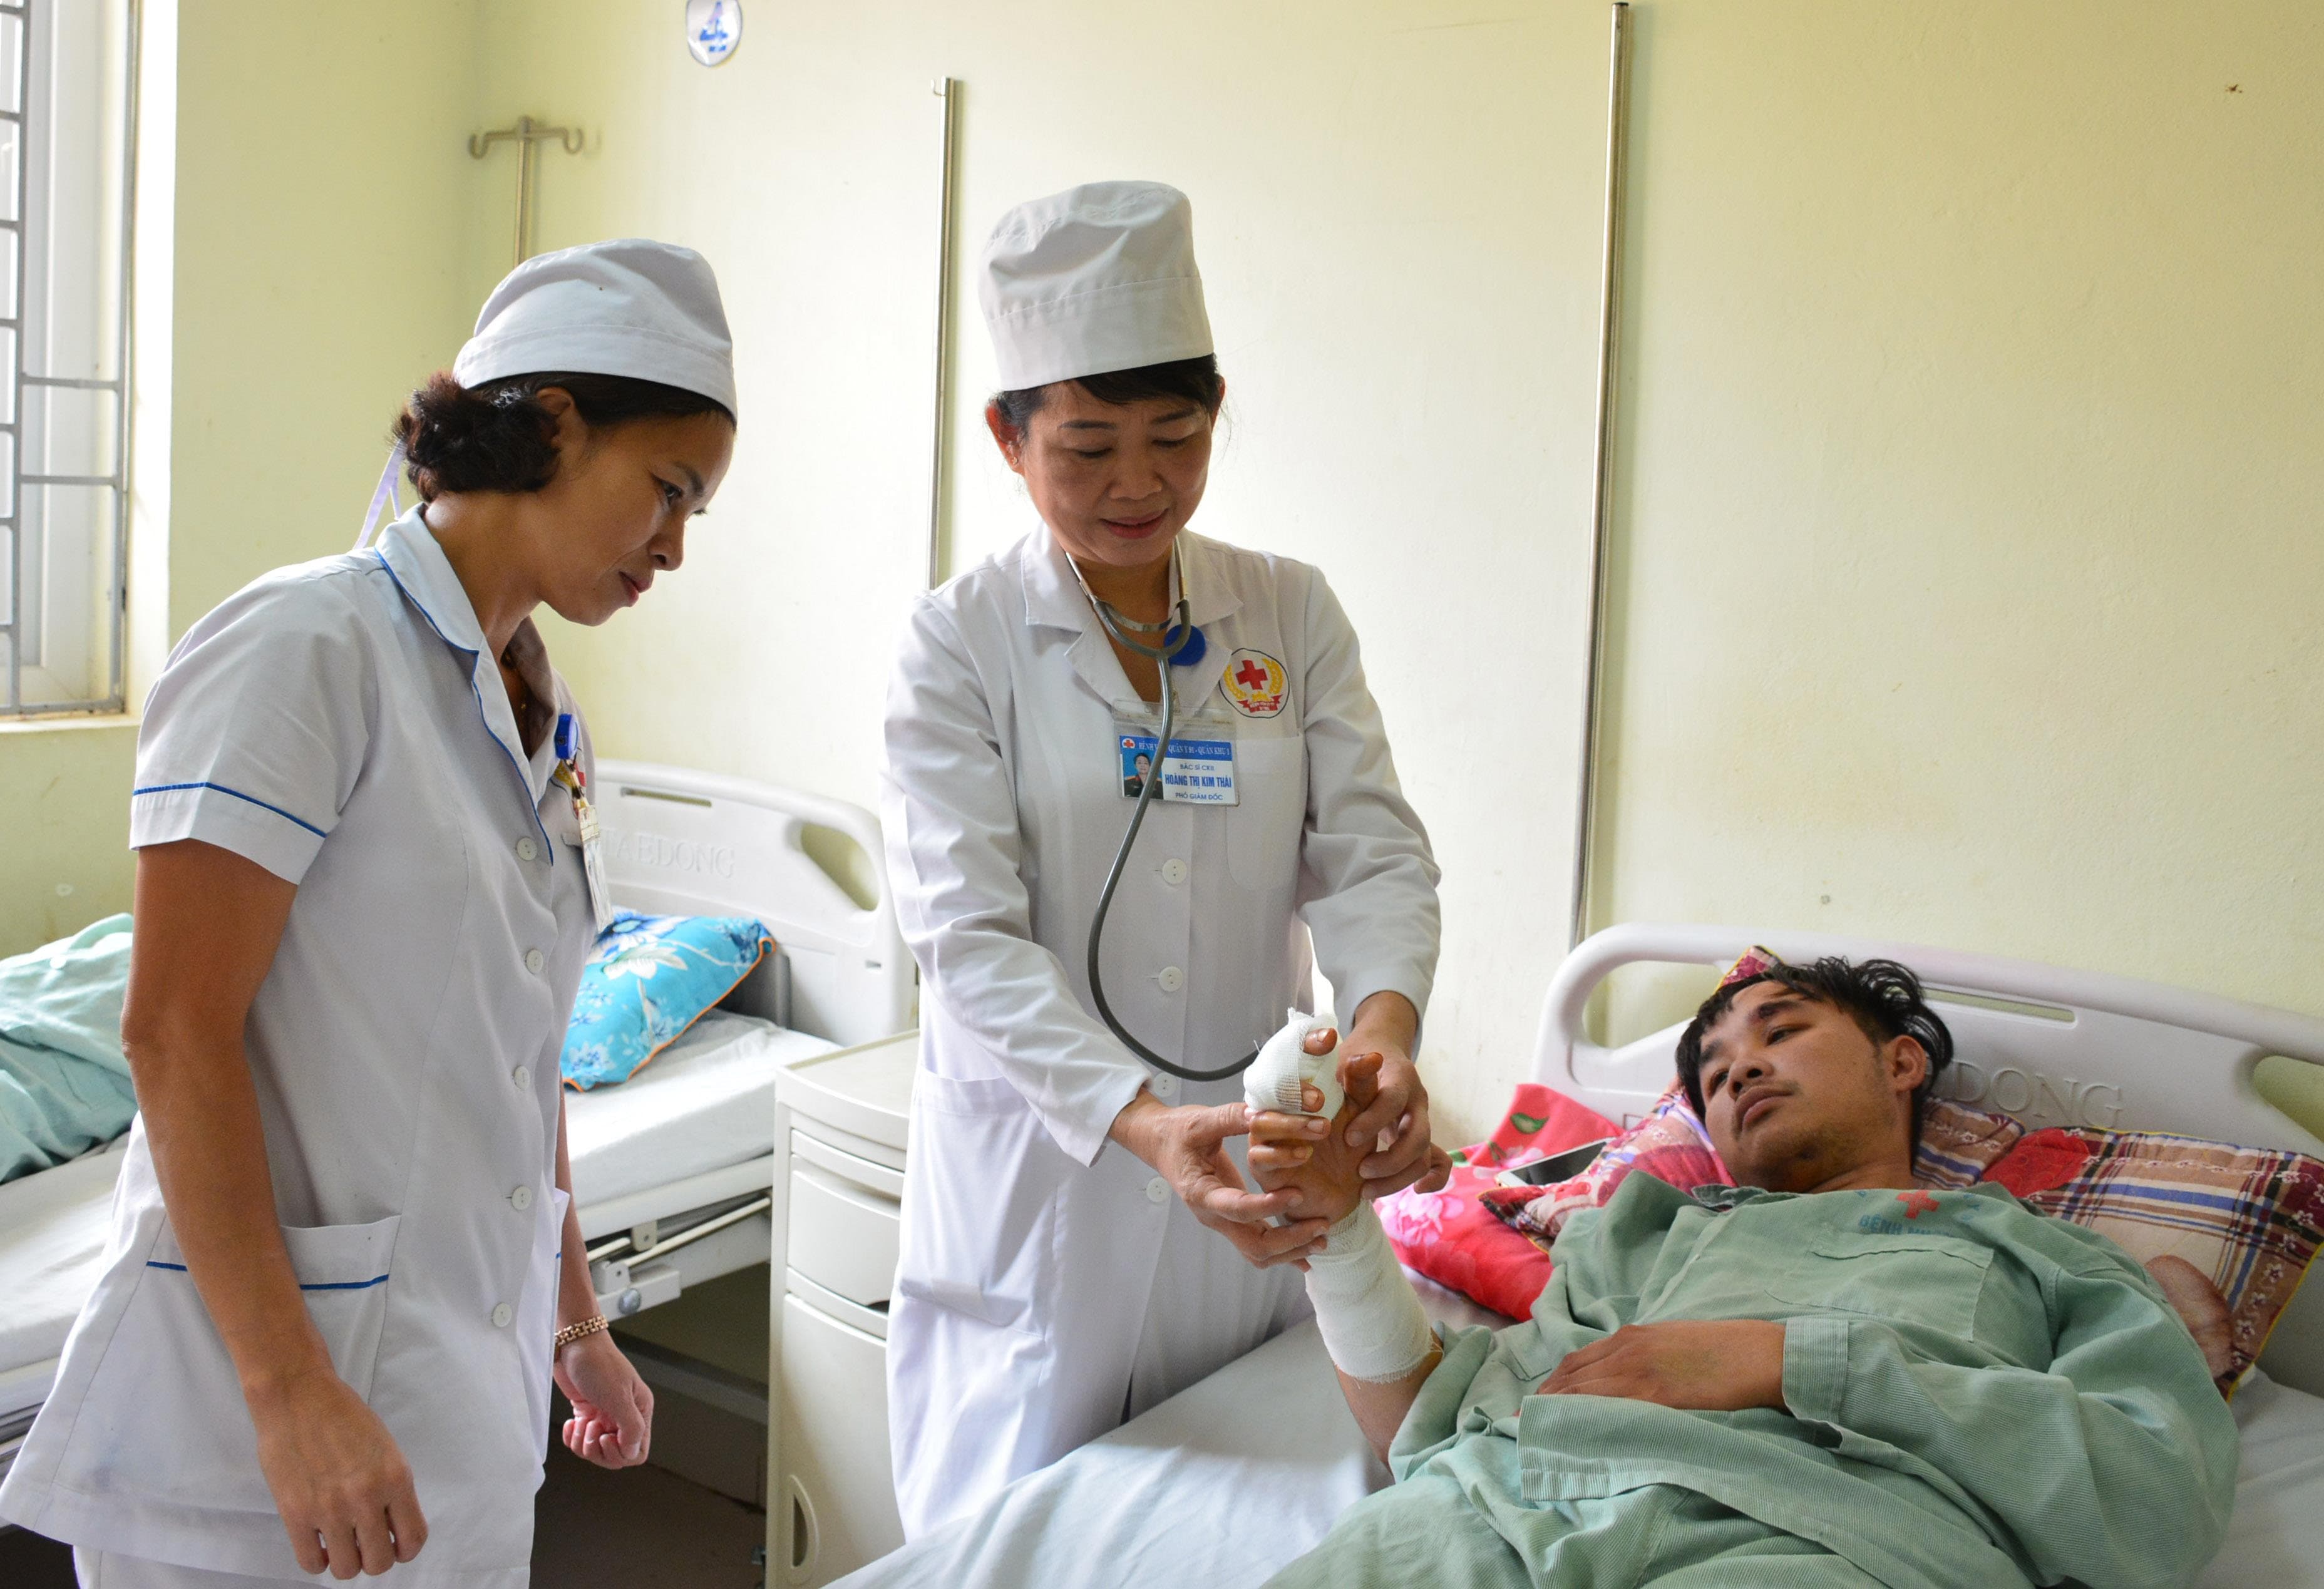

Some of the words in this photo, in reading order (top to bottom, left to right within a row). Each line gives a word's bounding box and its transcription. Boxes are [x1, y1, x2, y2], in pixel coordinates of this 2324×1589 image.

[1189, 775, 1200, 789] THỊ
[1201, 776, 1215, 787] KIM
[1949, 1059, 2124, 1129] DONG
